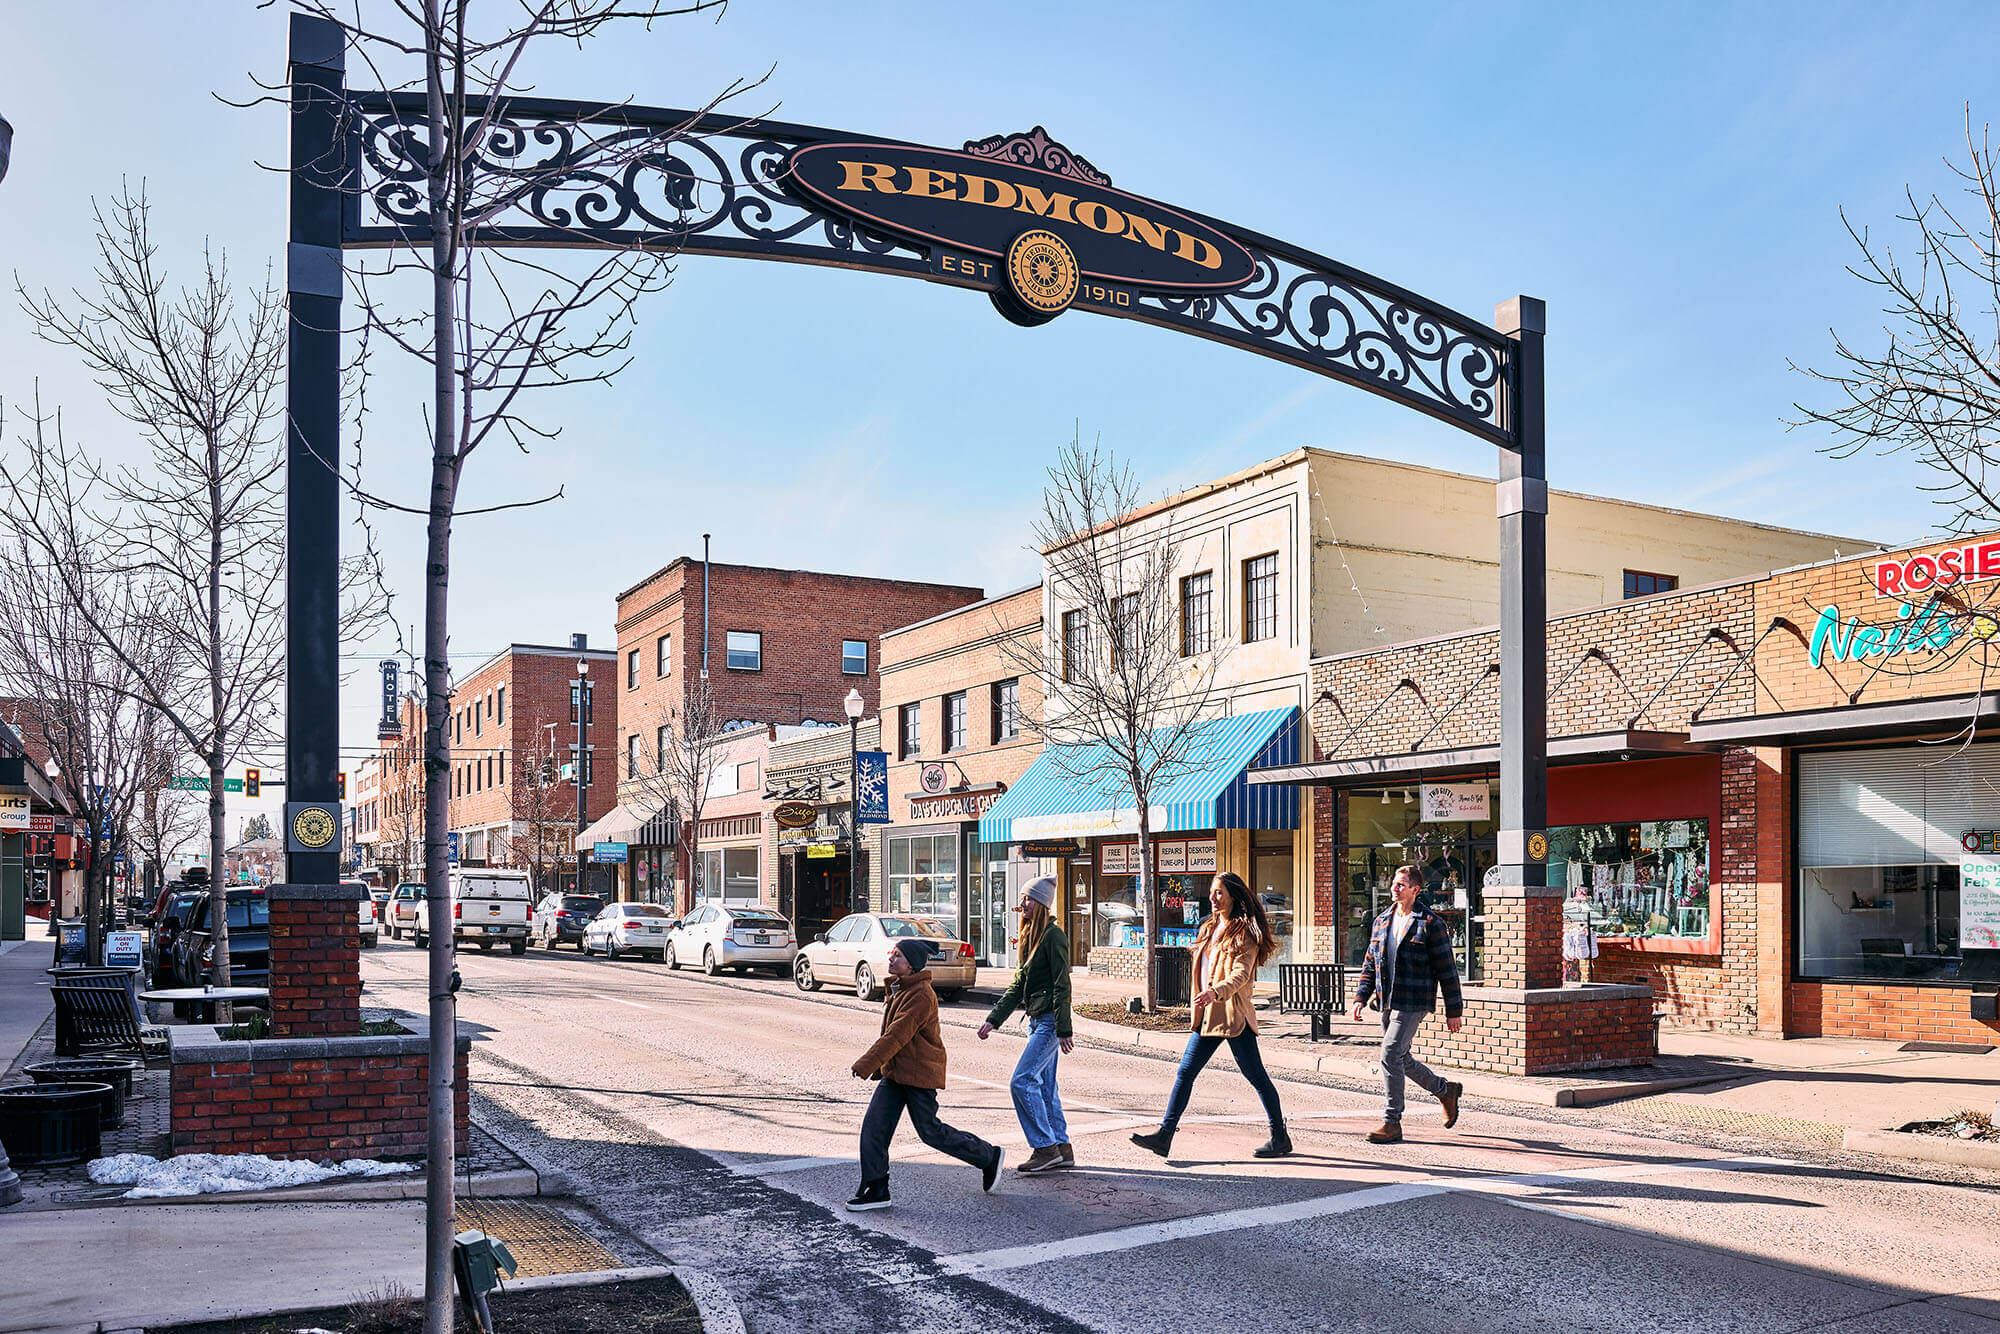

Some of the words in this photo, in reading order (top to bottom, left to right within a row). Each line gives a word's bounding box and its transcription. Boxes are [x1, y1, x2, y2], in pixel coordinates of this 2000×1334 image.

[837, 160, 1223, 270] REDMOND
[1025, 246, 1063, 267] REDMOND
[942, 255, 993, 278] EST
[1027, 277, 1043, 294] THE
[1046, 283, 1062, 296] HUB
[1083, 284, 1130, 306] 1910
[1809, 597, 1962, 668] Nails
[386, 673, 395, 723] HOTEL
[1428, 788, 1440, 798] TWO
[911, 801, 931, 819] IDA'S
[933, 797, 976, 817] CUPCAKE
[1, 812, 26, 821] Group
[1108, 848, 1121, 856] FREE
[1161, 847, 1183, 855] REPAIRS
[1188, 846, 1216, 854] DESKTOPS
[1160, 859, 1185, 867] TUNE-UPS
[1190, 857, 1215, 866] LAPTOPS
[1964, 877, 1990, 887] Feb
[1165, 896, 1185, 909] OPEN
